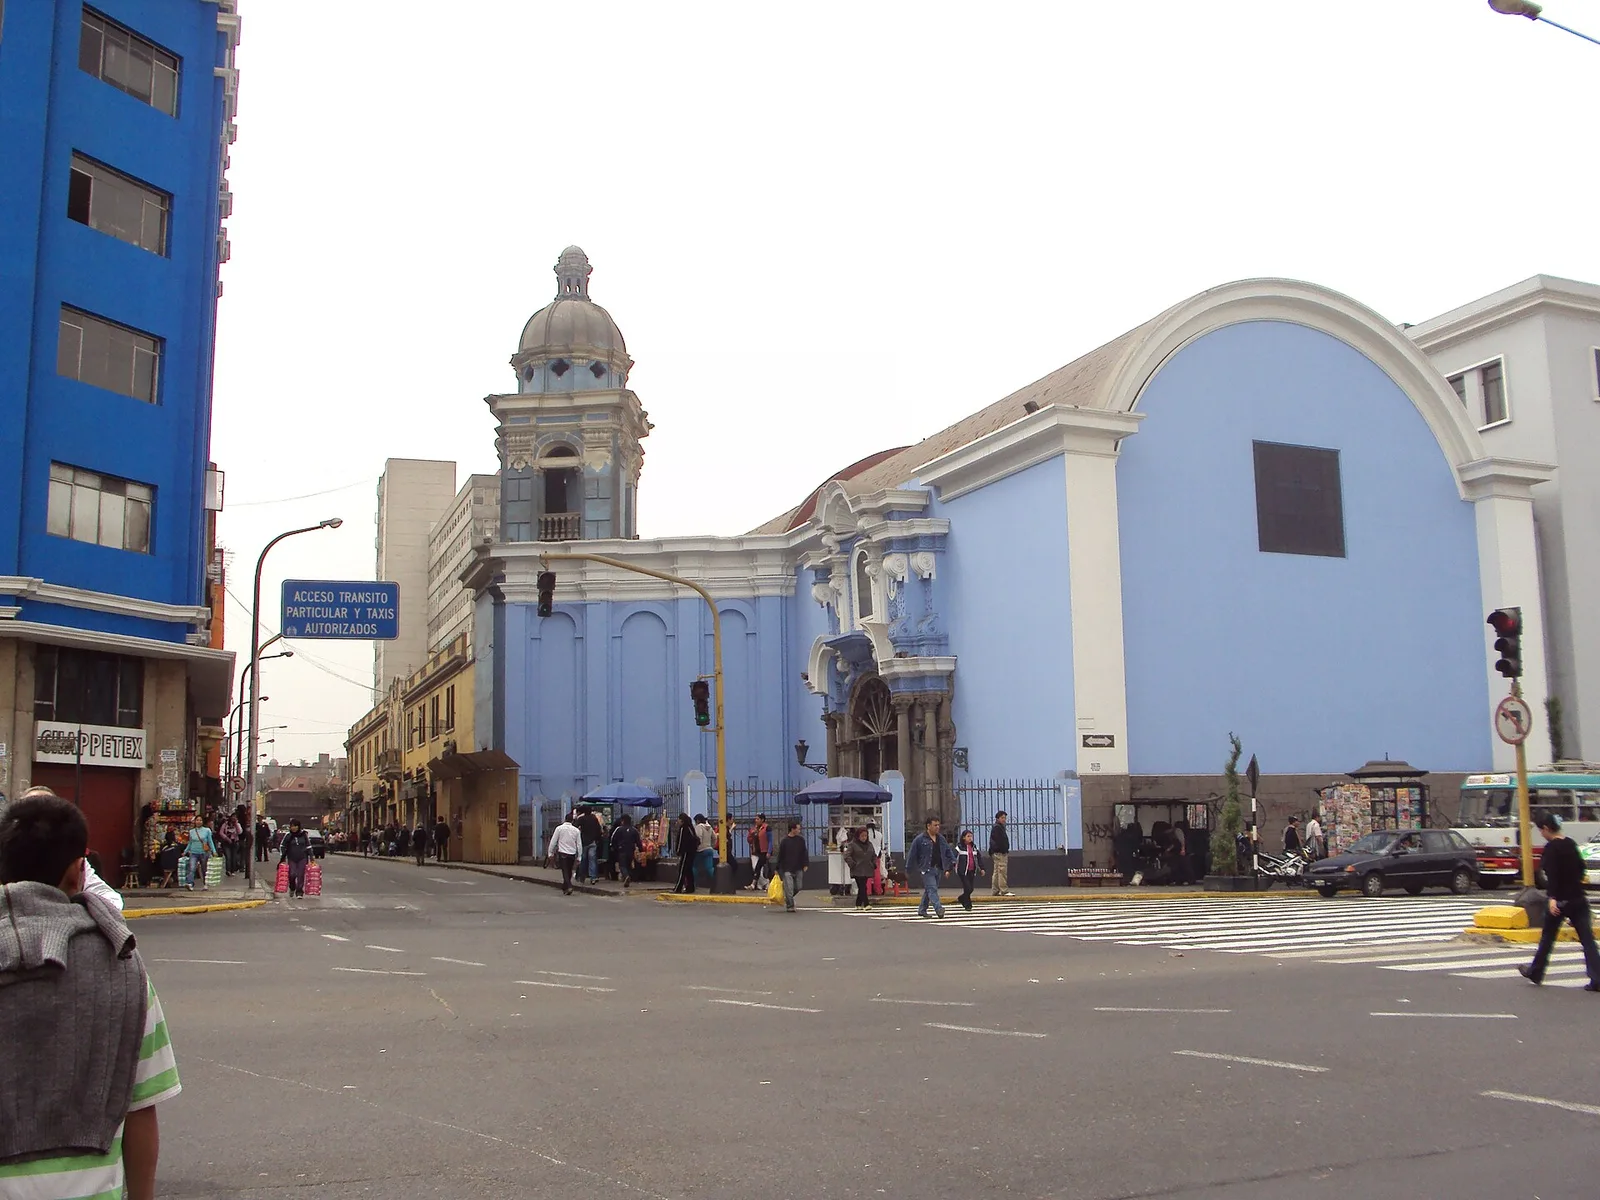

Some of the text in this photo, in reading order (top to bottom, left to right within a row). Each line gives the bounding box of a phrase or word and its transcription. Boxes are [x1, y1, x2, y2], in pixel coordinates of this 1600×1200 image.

[293, 591, 388, 604] ACCESO TRANSITO
[286, 606, 395, 620] PARTICULAR Y TAXIS
[304, 622, 378, 635] AUTORIZADOS
[41, 729, 143, 760] PPETEX
